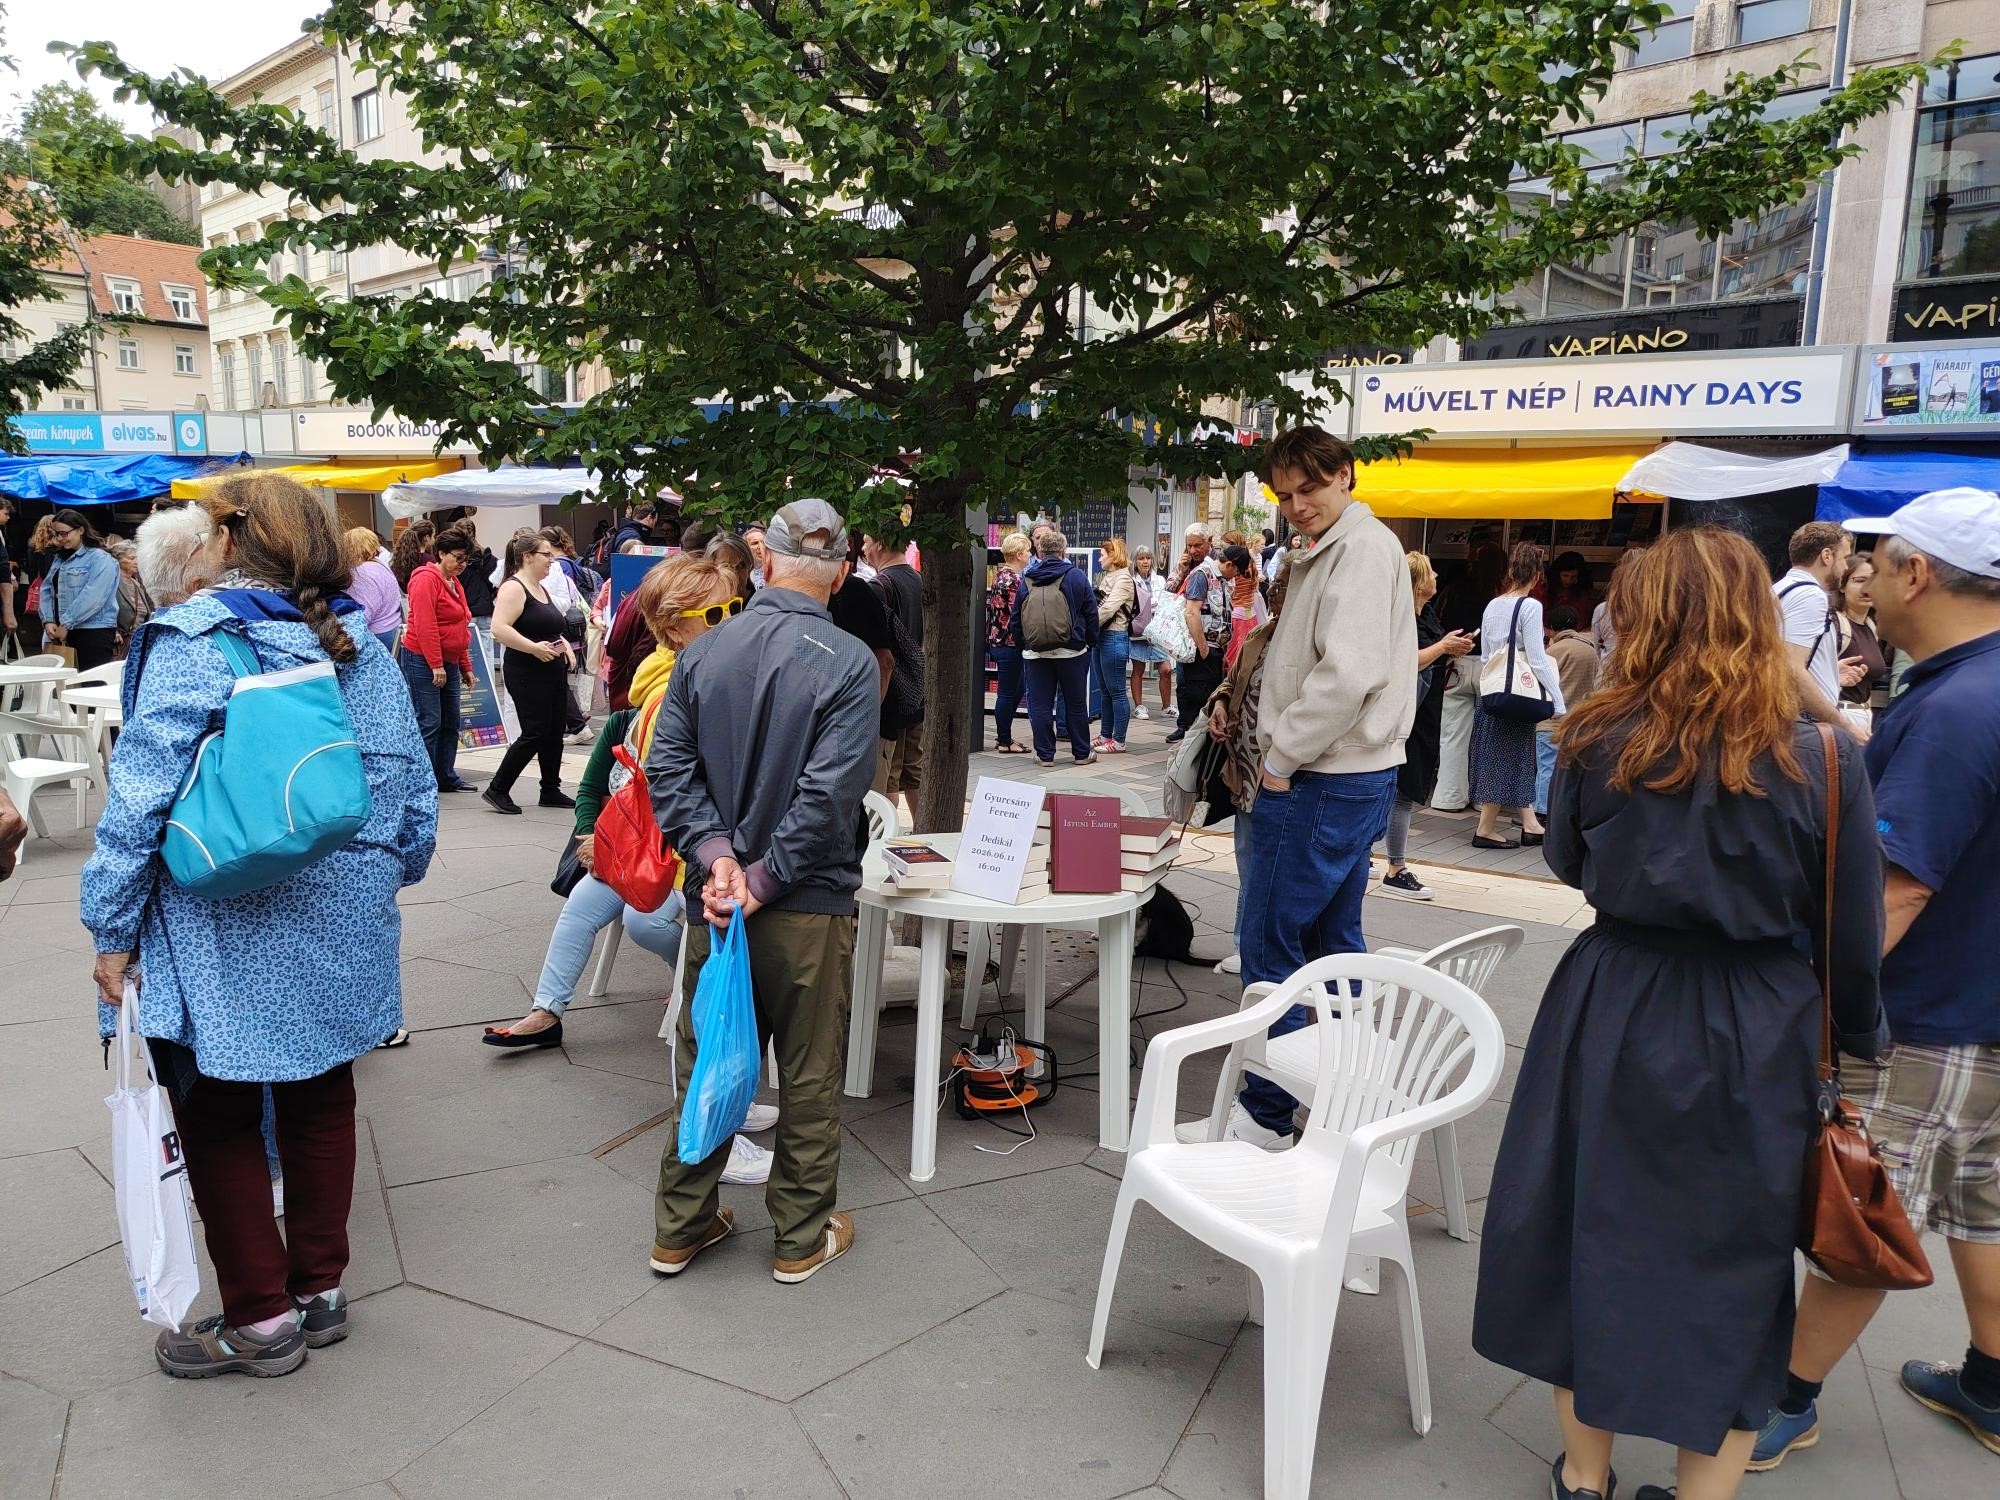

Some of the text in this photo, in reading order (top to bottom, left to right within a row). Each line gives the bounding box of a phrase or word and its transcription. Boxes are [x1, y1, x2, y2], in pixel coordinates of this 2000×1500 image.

[1384, 380, 1804, 413] MŰVELT NÉP RAINY DAYS
[347, 424, 396, 438] BOOOK
[989, 806, 1021, 819] Ferenc
[981, 833, 1013, 848] Dedikál
[978, 862, 1001, 873] 16:00
